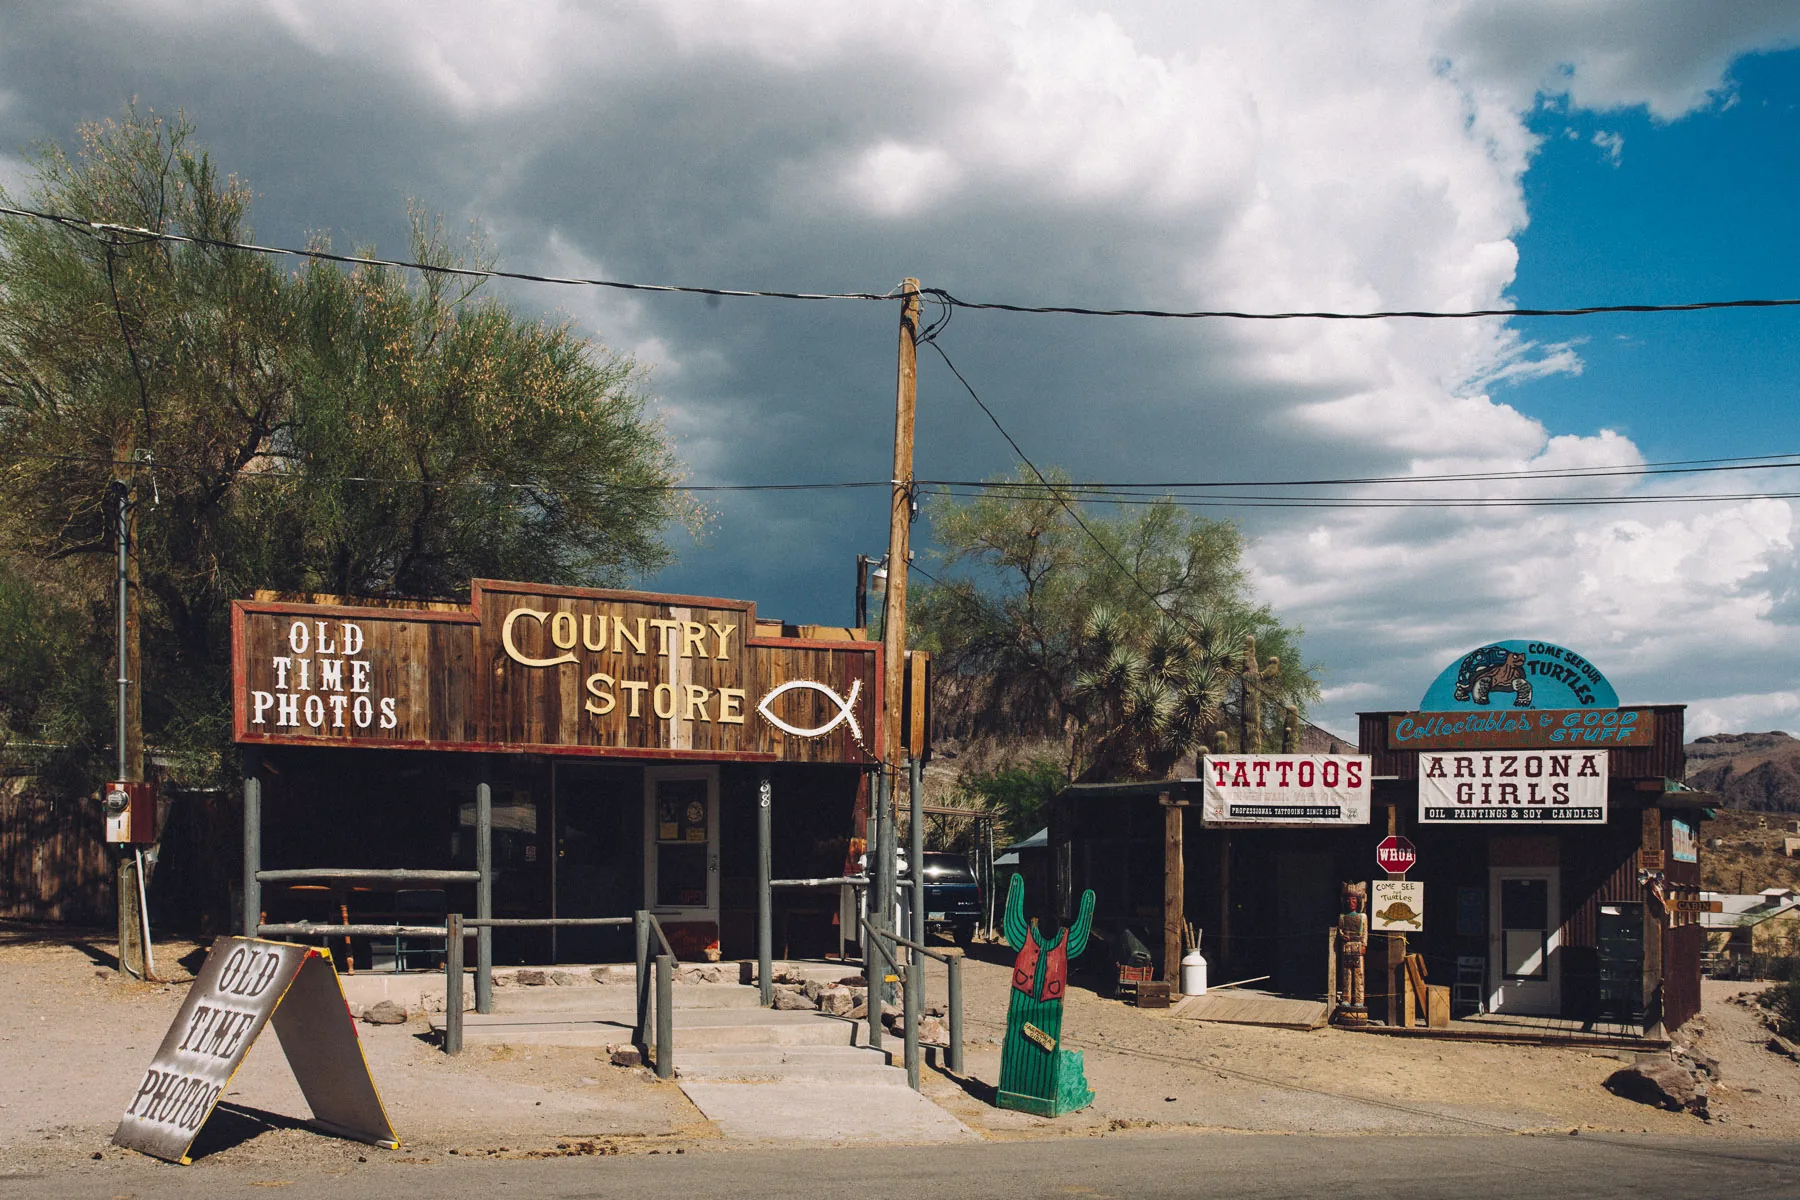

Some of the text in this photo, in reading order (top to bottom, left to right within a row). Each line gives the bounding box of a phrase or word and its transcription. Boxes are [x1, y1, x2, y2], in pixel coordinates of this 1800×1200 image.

[288, 621, 364, 655] OLD
[502, 607, 737, 667] COUNTRY
[272, 657, 371, 693] TIME
[1529, 643, 1602, 685] COME SEE OUR
[585, 672, 746, 725] STORE
[1527, 660, 1596, 705] TURTLES
[251, 691, 398, 729] PHOTOS
[1562, 711, 1638, 726] GOOD
[1550, 727, 1636, 742] STUFF
[1213, 761, 1362, 788] TATTOOS
[1427, 755, 1600, 778] ARIZONA
[1456, 783, 1570, 804] GIRLS
[1429, 809, 1600, 819] OIL PAINTINGS & SOY CANDLES
[1379, 848, 1413, 861] WHOA
[1376, 882, 1415, 892] COME SEE
[218, 947, 280, 997] OLD
[178, 1006, 257, 1059] TIME
[126, 1069, 222, 1132] PHOTOS
